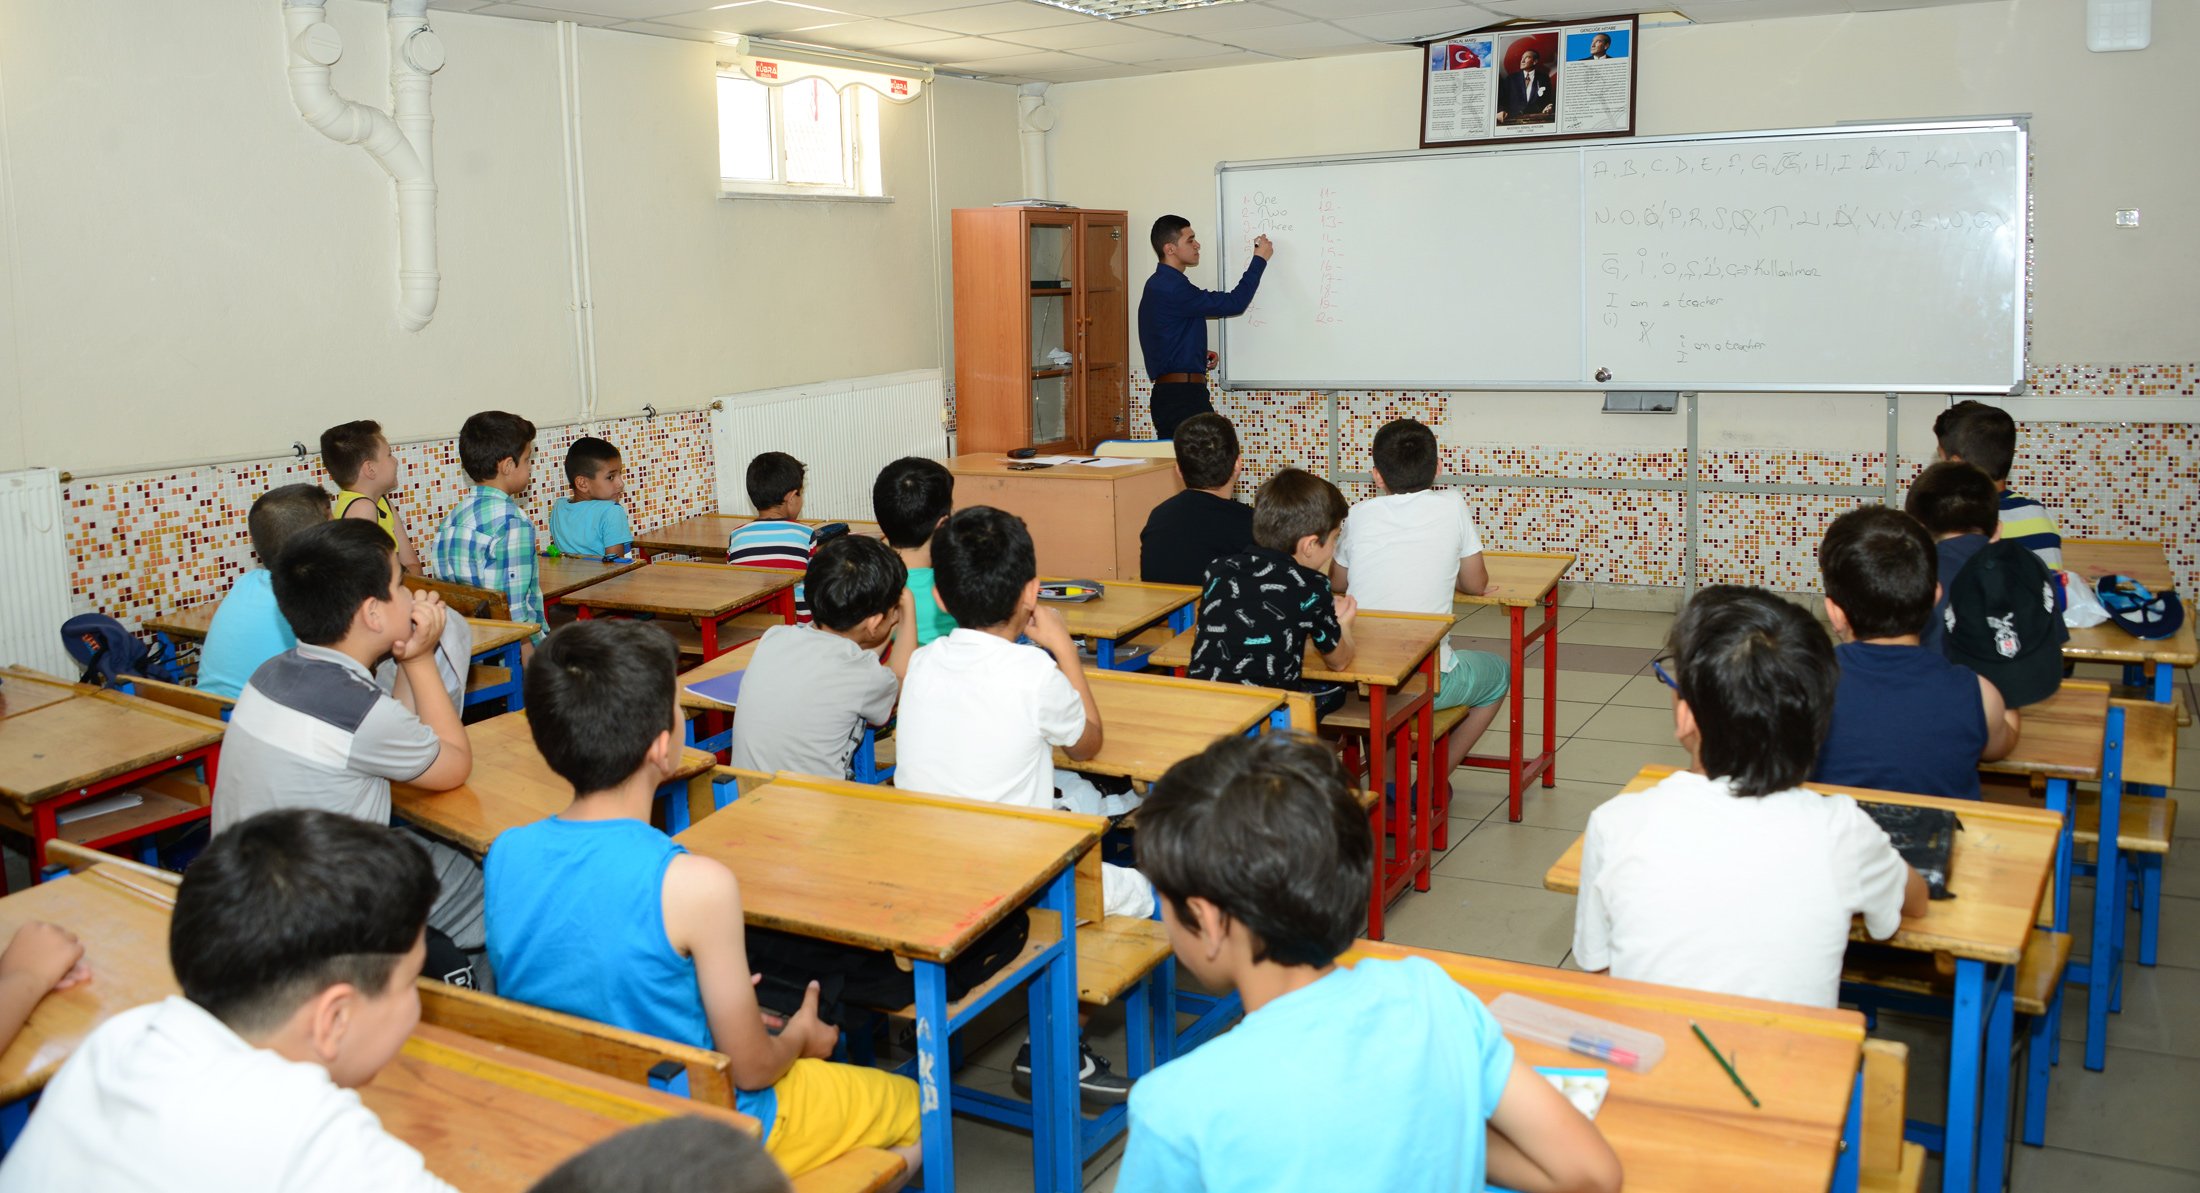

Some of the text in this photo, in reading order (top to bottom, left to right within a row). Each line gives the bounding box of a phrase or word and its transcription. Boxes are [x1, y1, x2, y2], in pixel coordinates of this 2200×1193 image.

[1254, 191, 1278, 206] One
[1258, 204, 1288, 220] Two
[1258, 218, 1294, 232] Three
[1606, 292, 1618, 308] I
[1630, 300, 1648, 308] am
[1678, 293, 1724, 308] teacher
[1694, 342, 1710, 350] am
[1725, 339, 1766, 352] teacher
